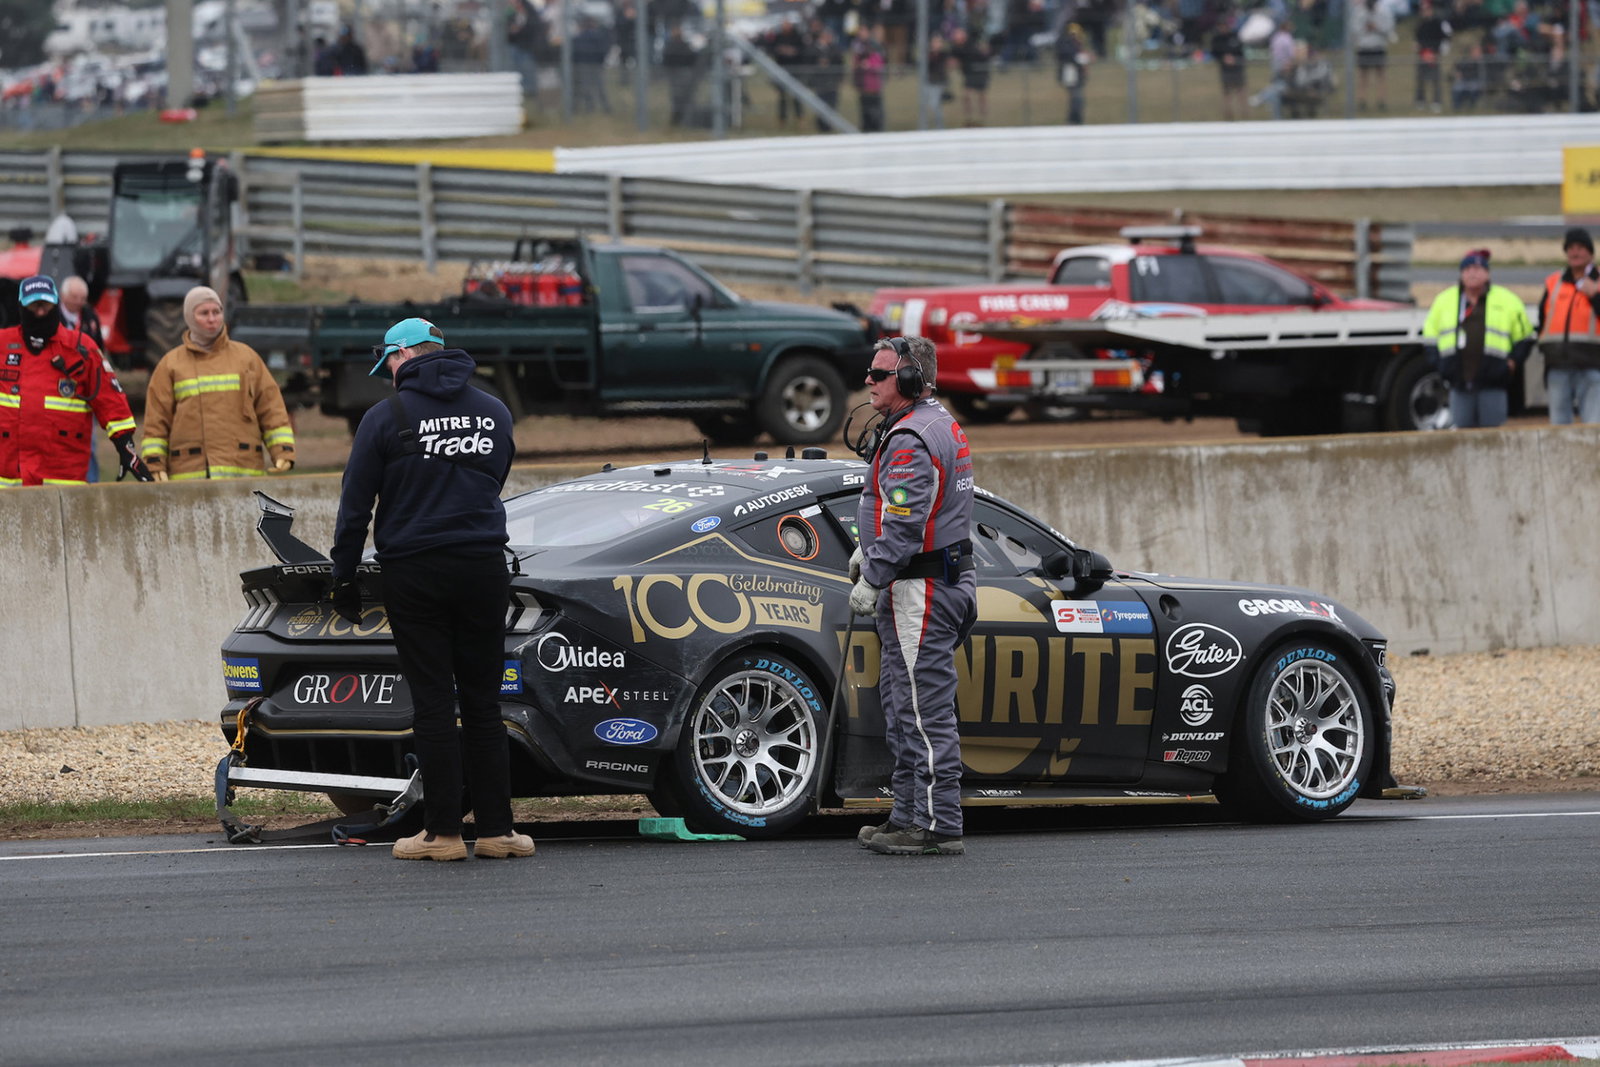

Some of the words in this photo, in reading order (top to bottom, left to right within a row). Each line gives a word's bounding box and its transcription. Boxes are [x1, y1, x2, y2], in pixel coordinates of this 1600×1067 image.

[979, 295, 1014, 312] FIRE
[1018, 294, 1069, 311] CREW
[418, 416, 471, 434] MITRE
[475, 416, 496, 431] 10
[418, 431, 494, 459] Trade
[534, 480, 690, 495] eadfast
[642, 498, 694, 514] 26
[748, 484, 813, 512] AUTODESK
[729, 573, 825, 604] Celebrating
[287, 614, 324, 626] PENRITE
[760, 602, 812, 625] YEARS
[1112, 610, 1149, 621] Tyrepower
[550, 645, 625, 668] Midea
[1170, 629, 1240, 673] Gates
[1277, 648, 1337, 671] DUNLOP
[223, 660, 259, 679] Bowens
[836, 629, 1156, 726] PNRITE
[500, 683, 518, 691] OICE
[754, 658, 822, 712] DUNLOP
[563, 685, 621, 706] APEX
[623, 691, 669, 701] STEEL
[1180, 699, 1214, 712] ACL
[605, 721, 646, 741] Ford
[1169, 732, 1225, 741] DUNLOP
[1174, 749, 1211, 763] Repco
[585, 760, 649, 773] RACING
